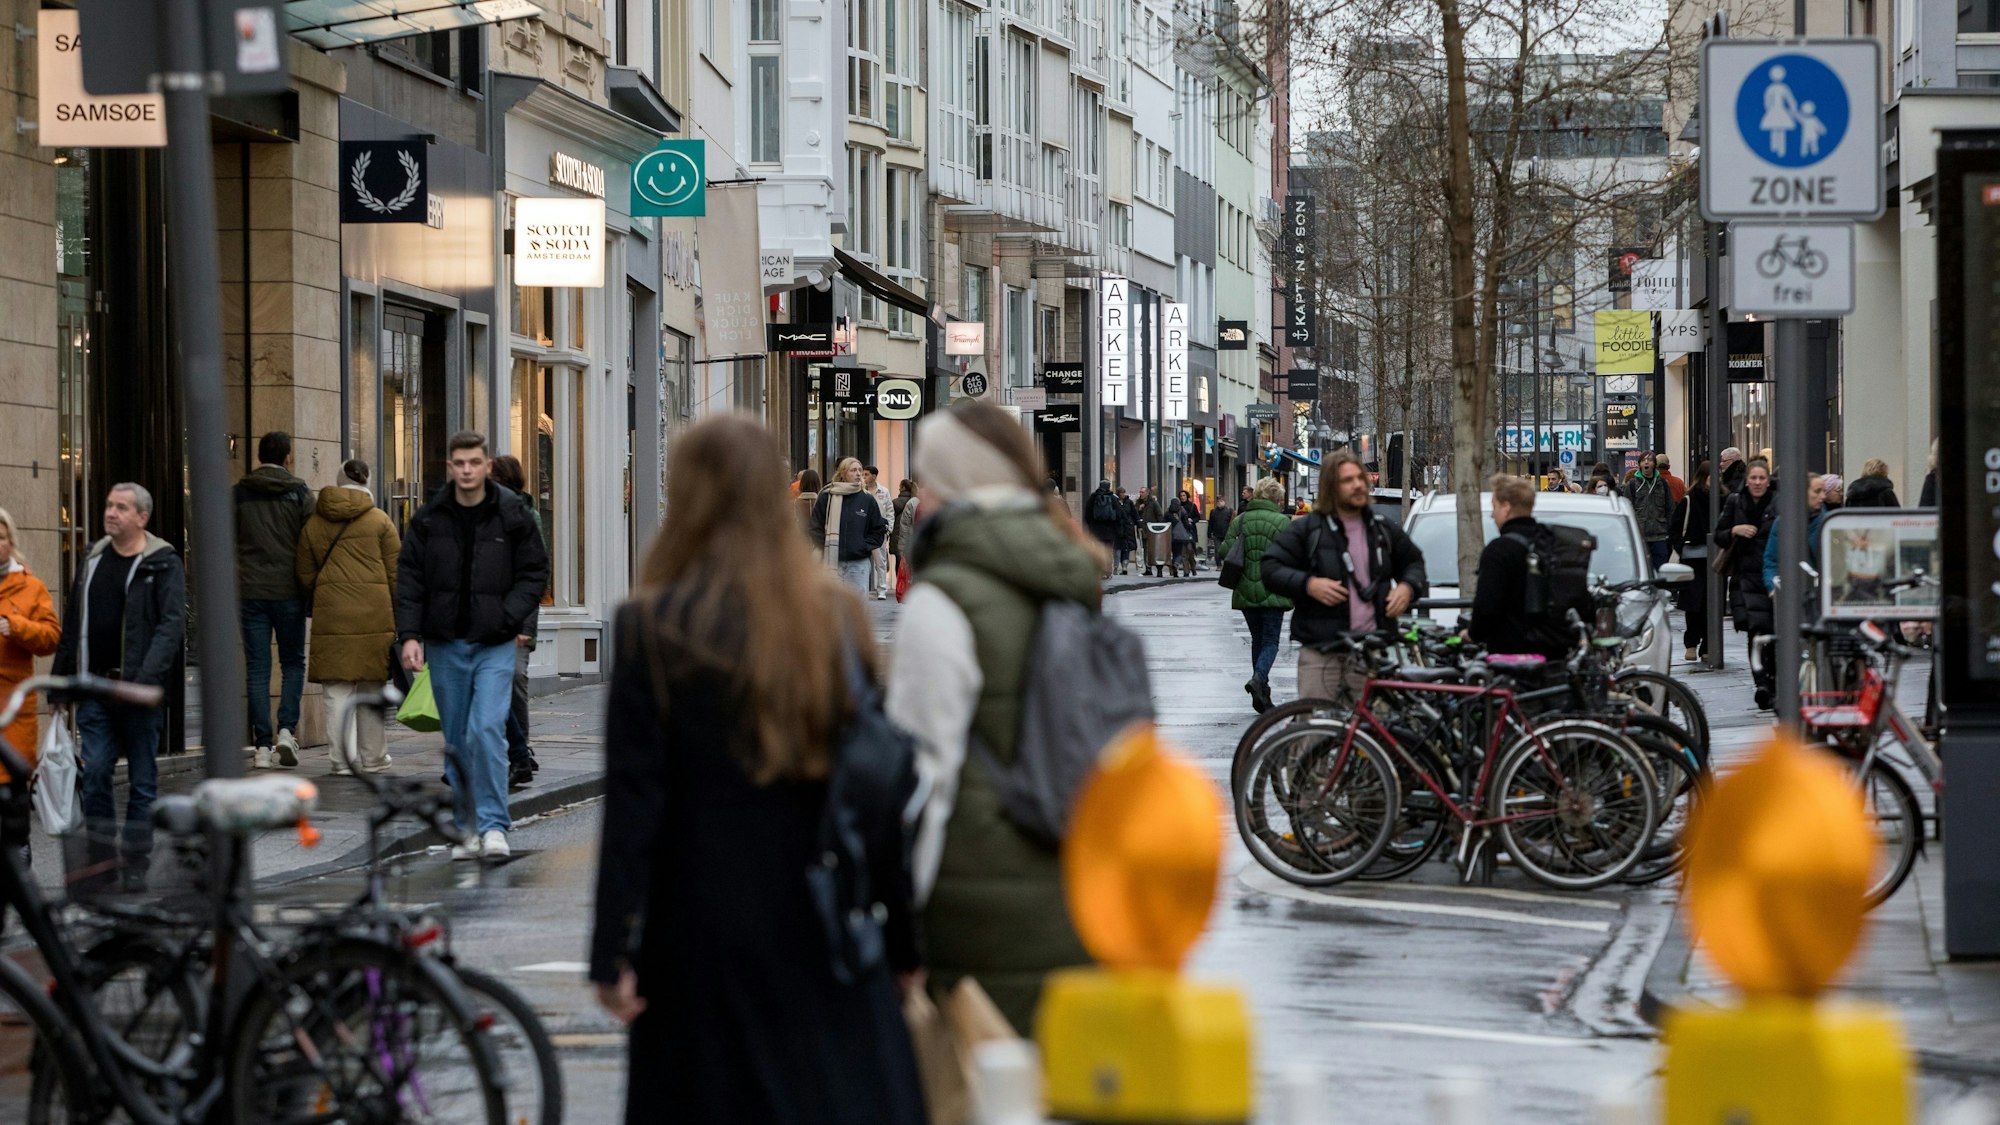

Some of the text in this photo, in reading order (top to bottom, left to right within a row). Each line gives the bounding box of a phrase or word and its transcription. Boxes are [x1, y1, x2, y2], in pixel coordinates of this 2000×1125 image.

[56, 103, 157, 122] SAMSØE
[556, 151, 583, 189] SCOTCH
[588, 164, 606, 198] SODA
[1750, 176, 1837, 205] ZONE
[1295, 201, 1306, 237] SON
[526, 224, 591, 237] SCOTCH
[529, 239, 591, 251] & SODA
[1295, 243, 1305, 254] &
[526, 252, 592, 260] AMSTERDAM
[763, 268, 785, 278] AGE
[1773, 284, 1813, 303] frei
[1607, 324, 1646, 341] little
[1667, 325, 1698, 337] YPS
[949, 333, 981, 347] Triumph
[1106, 283, 1123, 402] ARKET
[1602, 340, 1654, 352] FOODIE
[1168, 306, 1183, 417] ARKET
[1729, 353, 1763, 361] YELLOW
[1728, 360, 1763, 368] KORNER
[1045, 370, 1083, 378] CHANGE
[834, 390, 851, 398] NILE
[878, 394, 919, 405] ONLY
[1606, 404, 1637, 412] FITNESS
[1540, 430, 1588, 446] WERK
